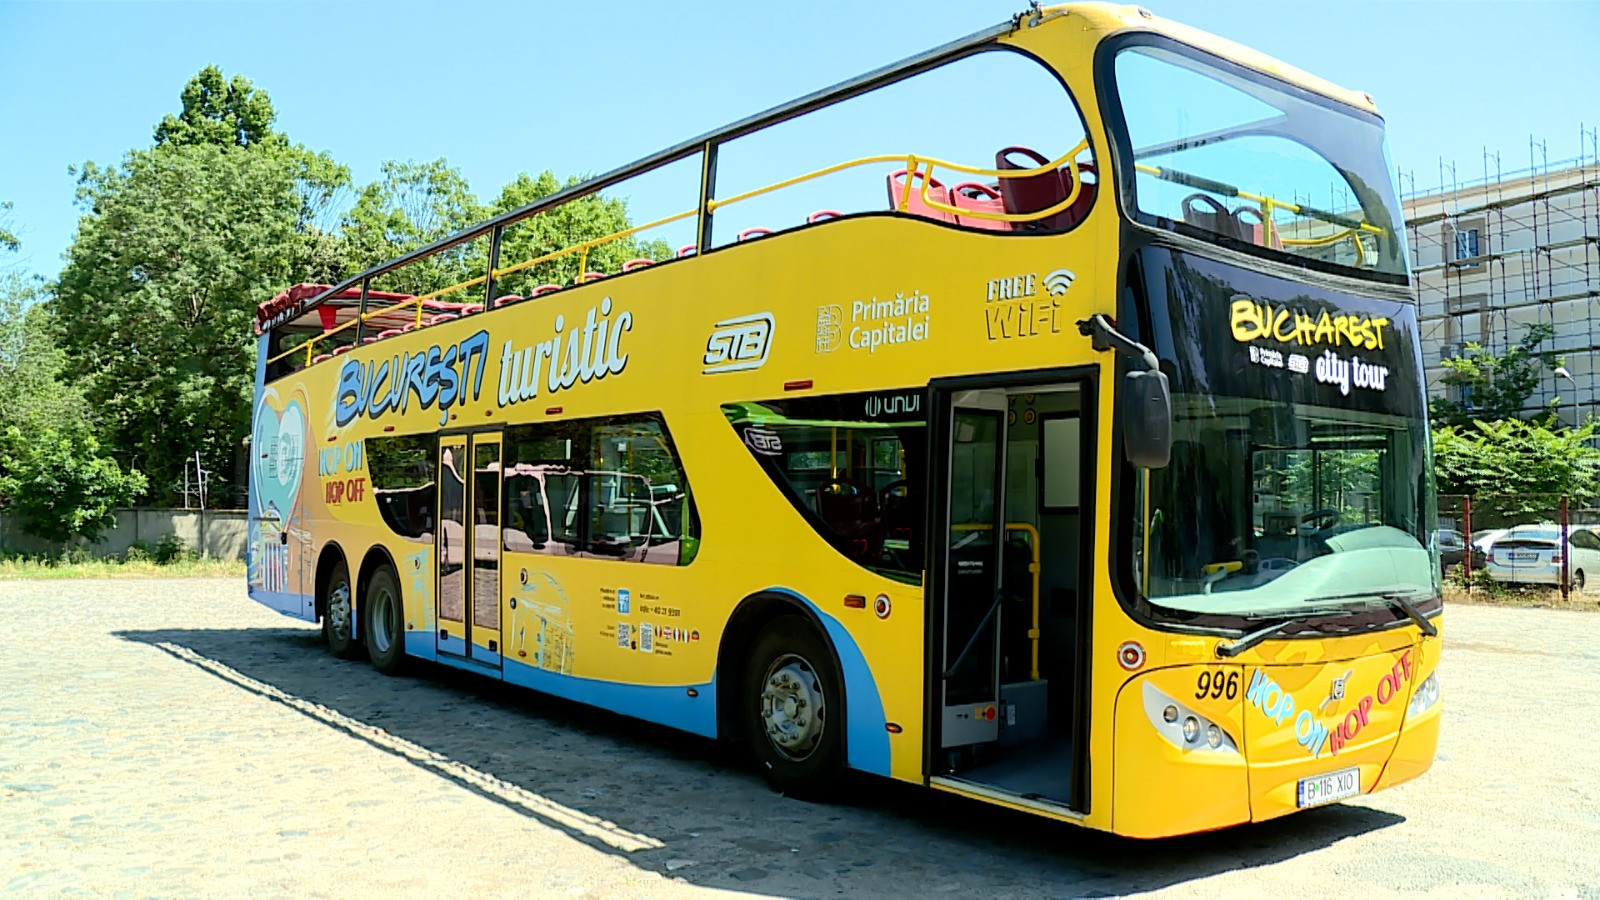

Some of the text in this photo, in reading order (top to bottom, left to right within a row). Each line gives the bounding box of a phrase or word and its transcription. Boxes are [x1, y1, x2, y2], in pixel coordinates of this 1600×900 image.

[851, 290, 929, 322] Primăria
[986, 273, 1037, 302] FREE
[849, 315, 929, 353] Capitalei
[1230, 299, 1388, 350] BUCHAREST
[498, 296, 632, 407] turistic
[703, 320, 770, 368] STB
[1316, 348, 1349, 396] city
[1352, 356, 1389, 391] tour
[318, 446, 341, 477] HOP
[344, 440, 363, 473] ON
[326, 478, 365, 504] HOP OFF
[1195, 671, 1239, 700] 996
[1330, 650, 1412, 756] HOP OFF
[1246, 669, 1329, 759] HOP ON
[1308, 773, 1353, 800] B 116 XIO
